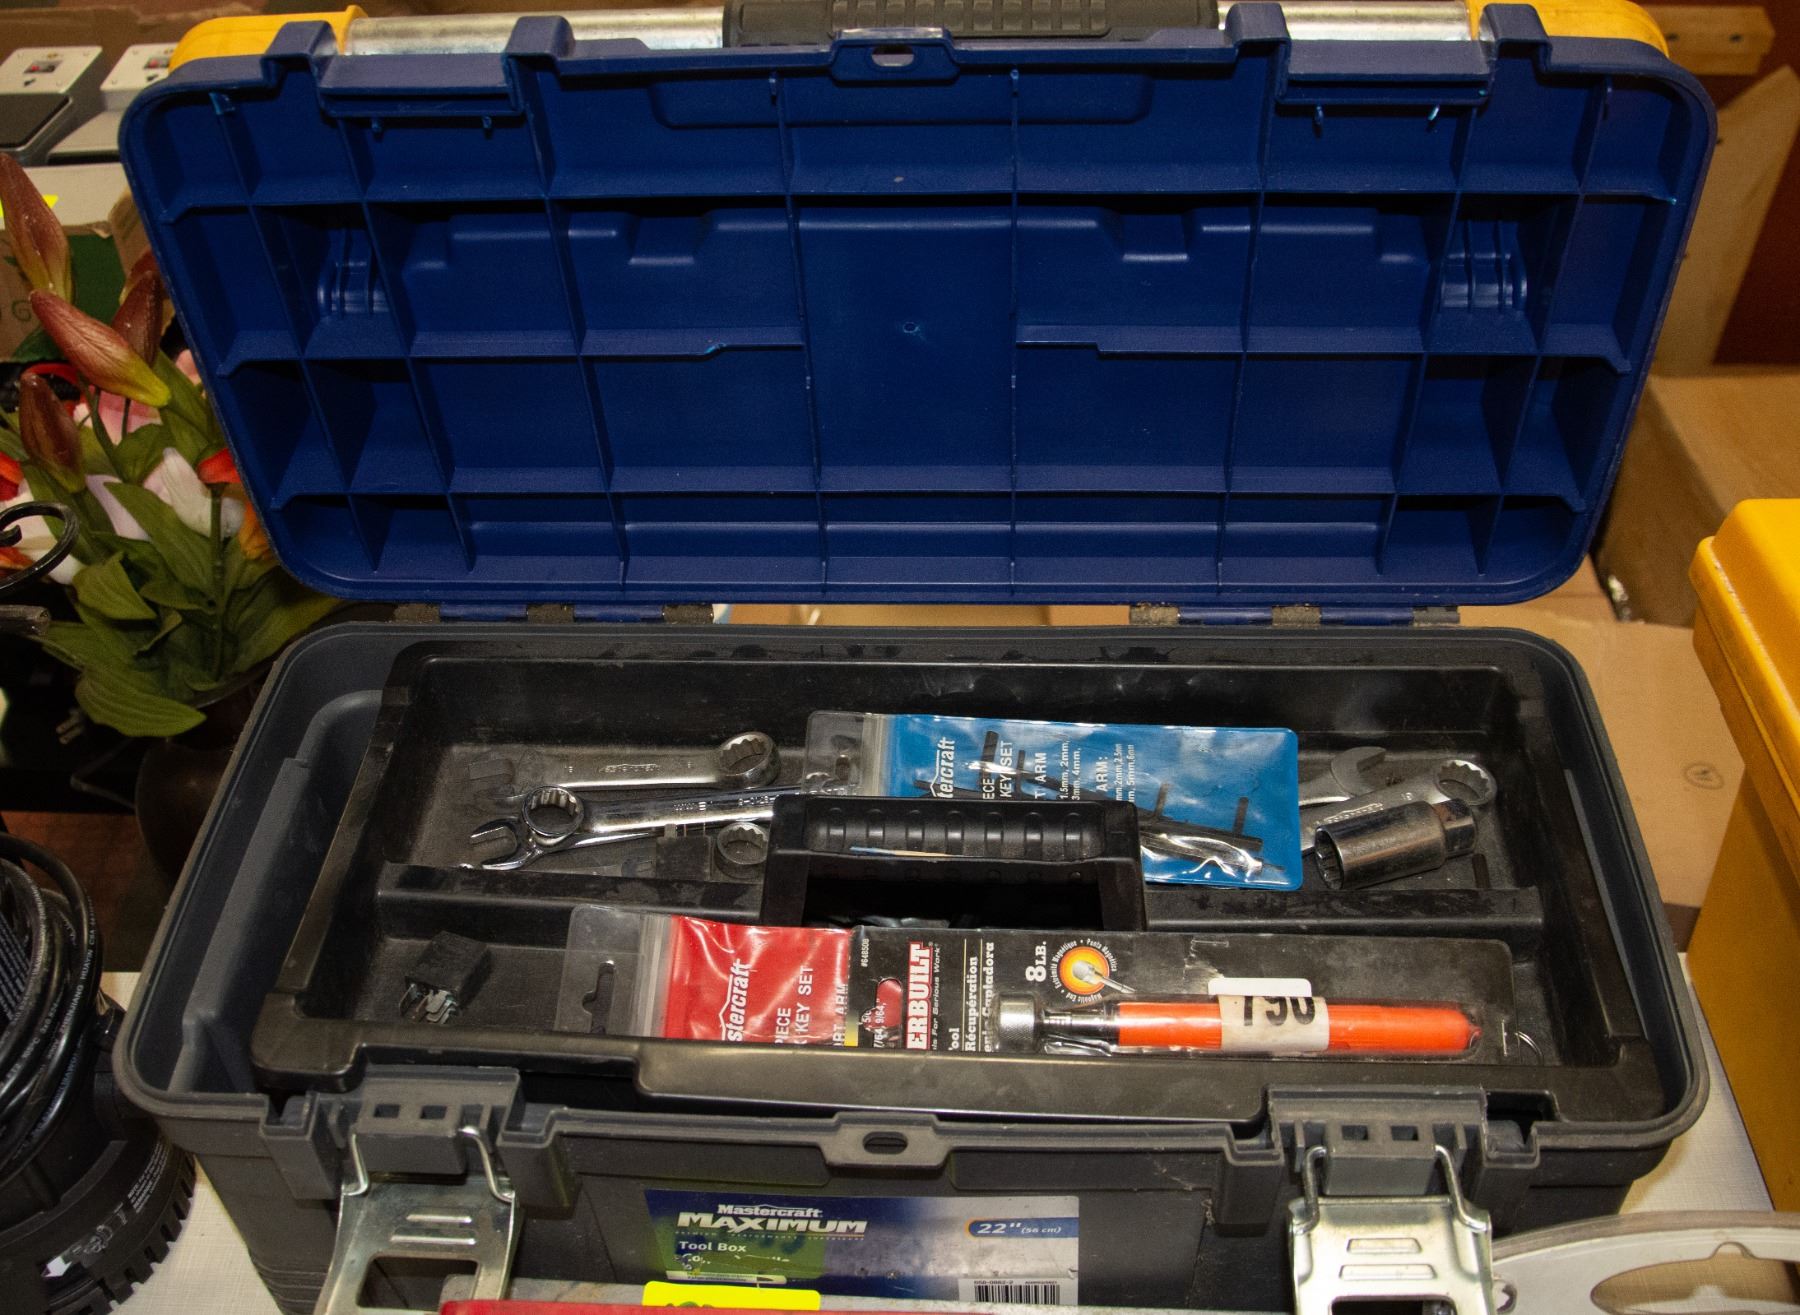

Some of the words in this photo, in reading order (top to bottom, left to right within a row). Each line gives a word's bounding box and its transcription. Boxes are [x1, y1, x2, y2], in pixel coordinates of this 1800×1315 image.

[936, 736, 956, 799] tercraft
[1000, 740, 1013, 766] SET
[1035, 752, 1047, 783] ARM
[982, 778, 995, 799] ECE
[1000, 775, 1012, 797] KEY
[1096, 756, 1108, 792] ARM:
[798, 965, 814, 996] SET
[932, 976, 940, 1015] Serious
[725, 958, 752, 1043] stercraft
[907, 943, 930, 1050] ERBUILT
[965, 956, 979, 1052] Récupération
[795, 1001, 810, 1032] KEY
[948, 1027, 960, 1051] ool
[676, 1211, 868, 1233] MAXIMUM
[717, 1204, 822, 1218] Mastercraft
[1041, 1226, 1062, 1234] cm)
[679, 1240, 713, 1251] Tool
[717, 1242, 747, 1253] Box
